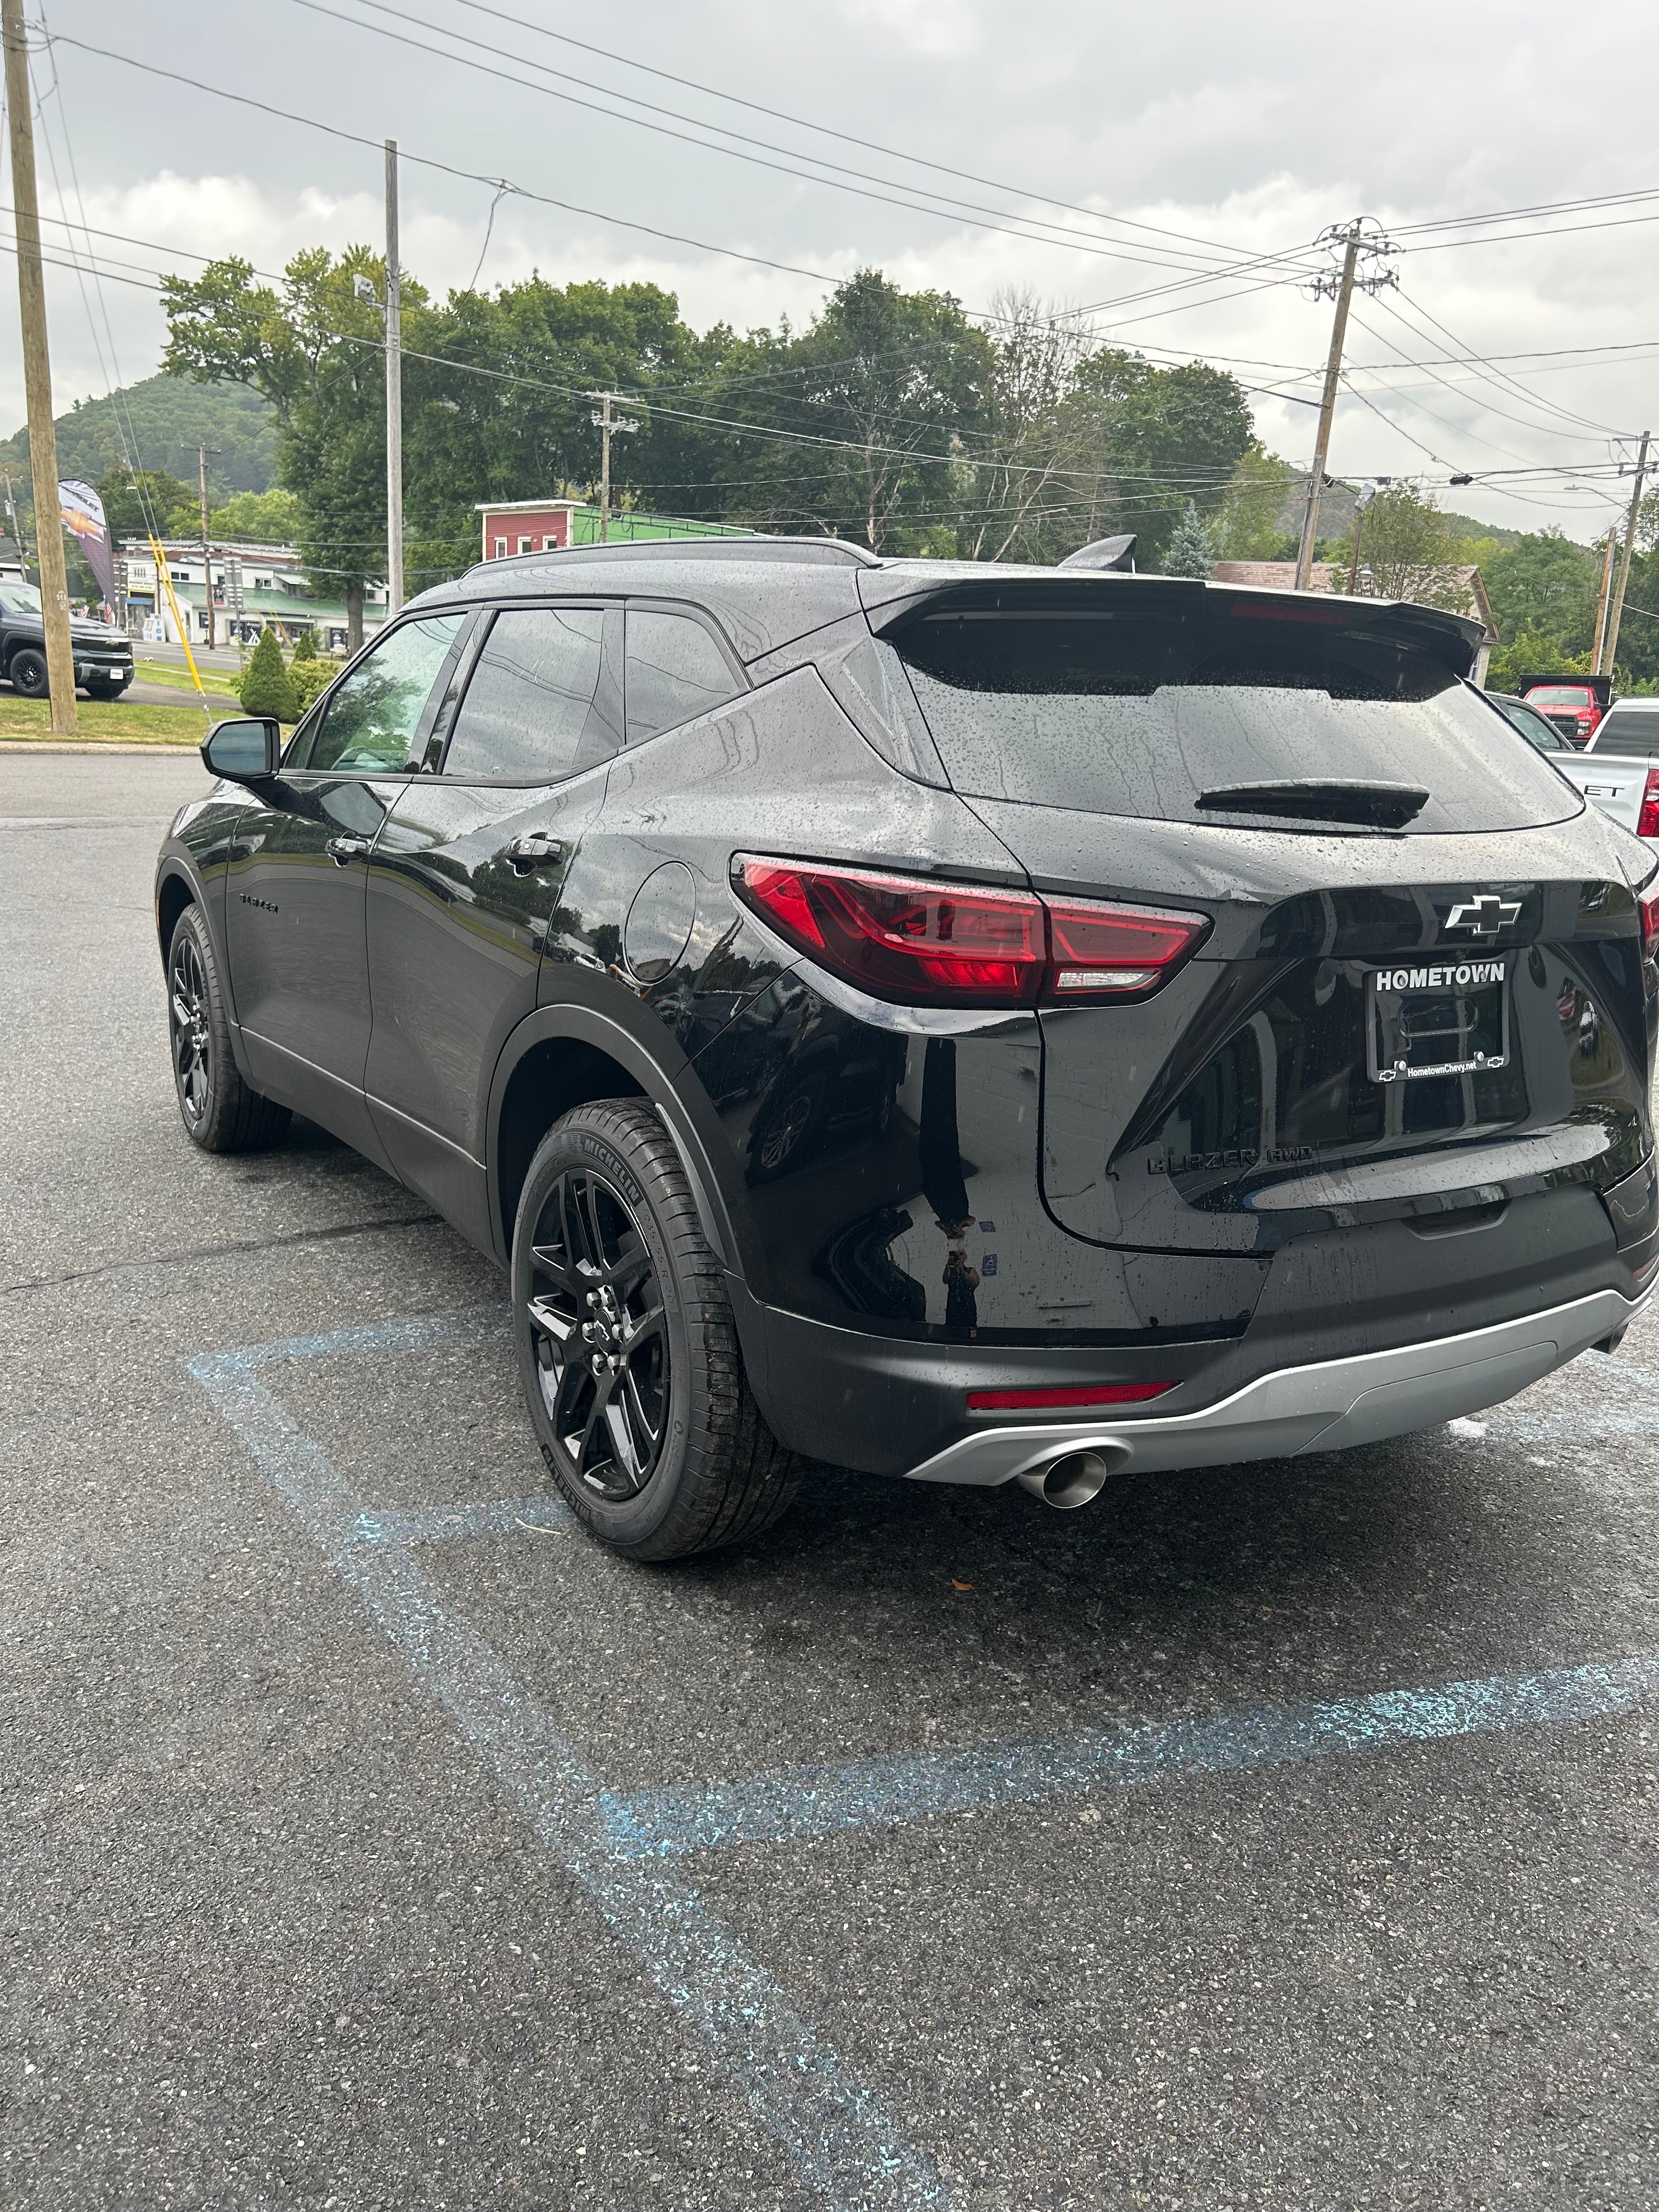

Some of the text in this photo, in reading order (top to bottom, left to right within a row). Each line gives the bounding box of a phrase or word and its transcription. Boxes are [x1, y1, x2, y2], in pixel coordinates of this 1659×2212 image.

[240, 893, 279, 915] BLAZER
[1377, 963, 1505, 991] HOMETOWN
[1407, 1061, 1477, 1077] HometownChevy.net
[584, 1139, 640, 1203] MICHELIN
[1148, 1146, 1312, 1175] BLAZER AWD
[644, 1214, 665, 1263] 235/55
[662, 1270, 668, 1278] R
[543, 1447, 591, 1521] MICHELIN
